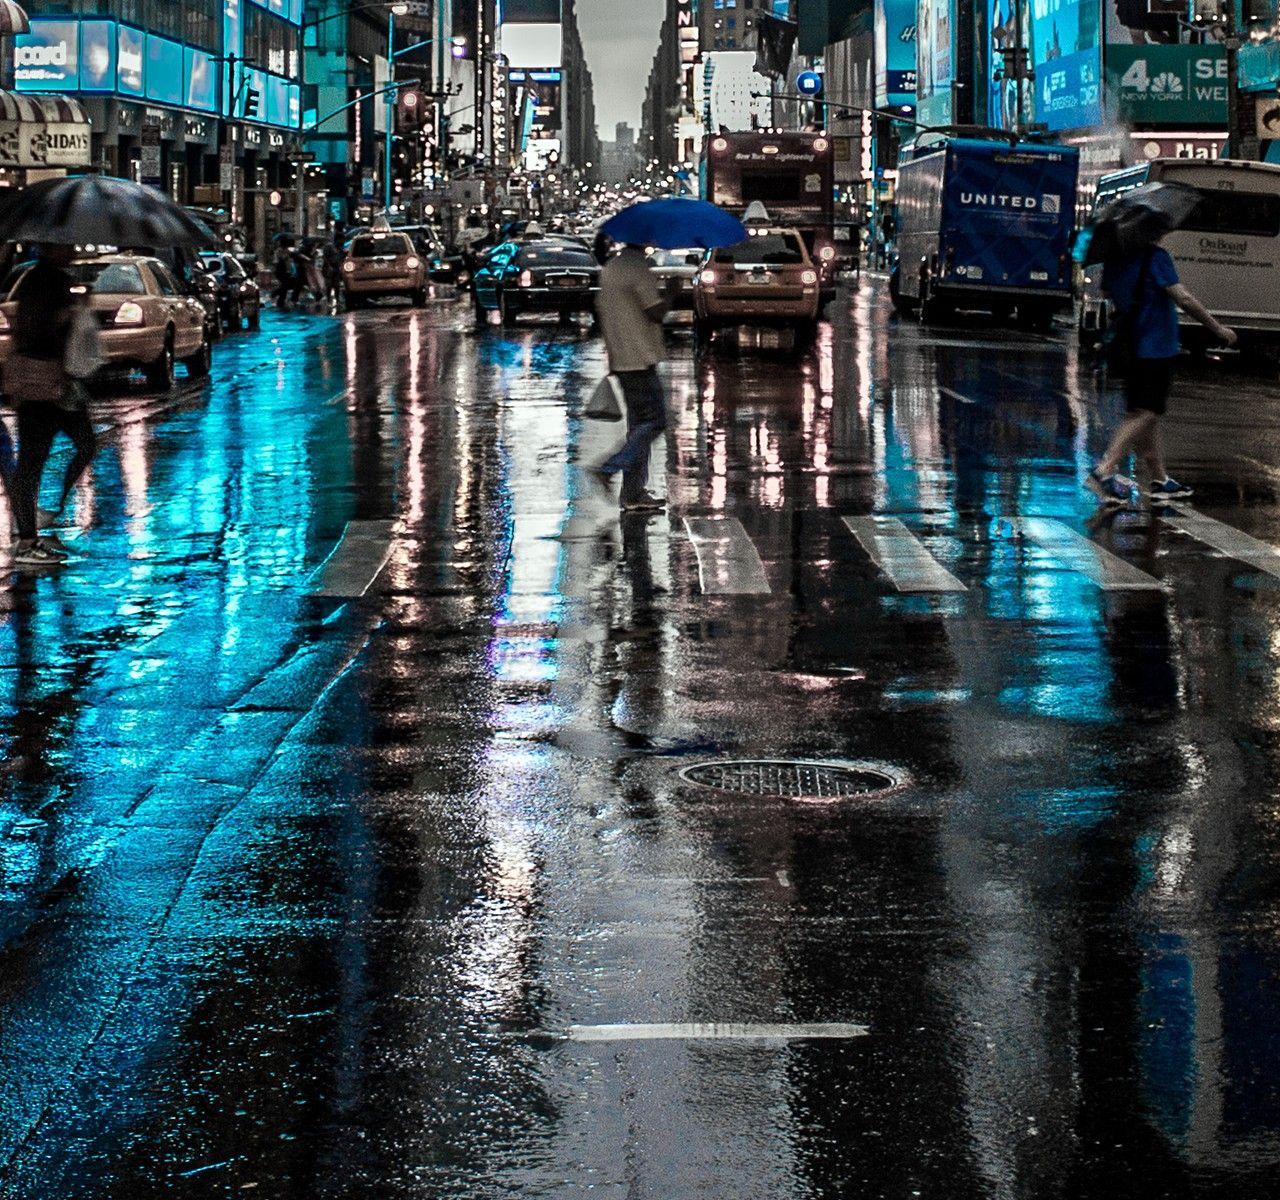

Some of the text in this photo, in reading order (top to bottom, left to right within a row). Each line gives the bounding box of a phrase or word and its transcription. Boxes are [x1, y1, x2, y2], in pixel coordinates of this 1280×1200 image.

[1121, 59, 1150, 92] 4
[45, 134, 88, 149] RIDAY'S
[960, 192, 1037, 209] UNITED
